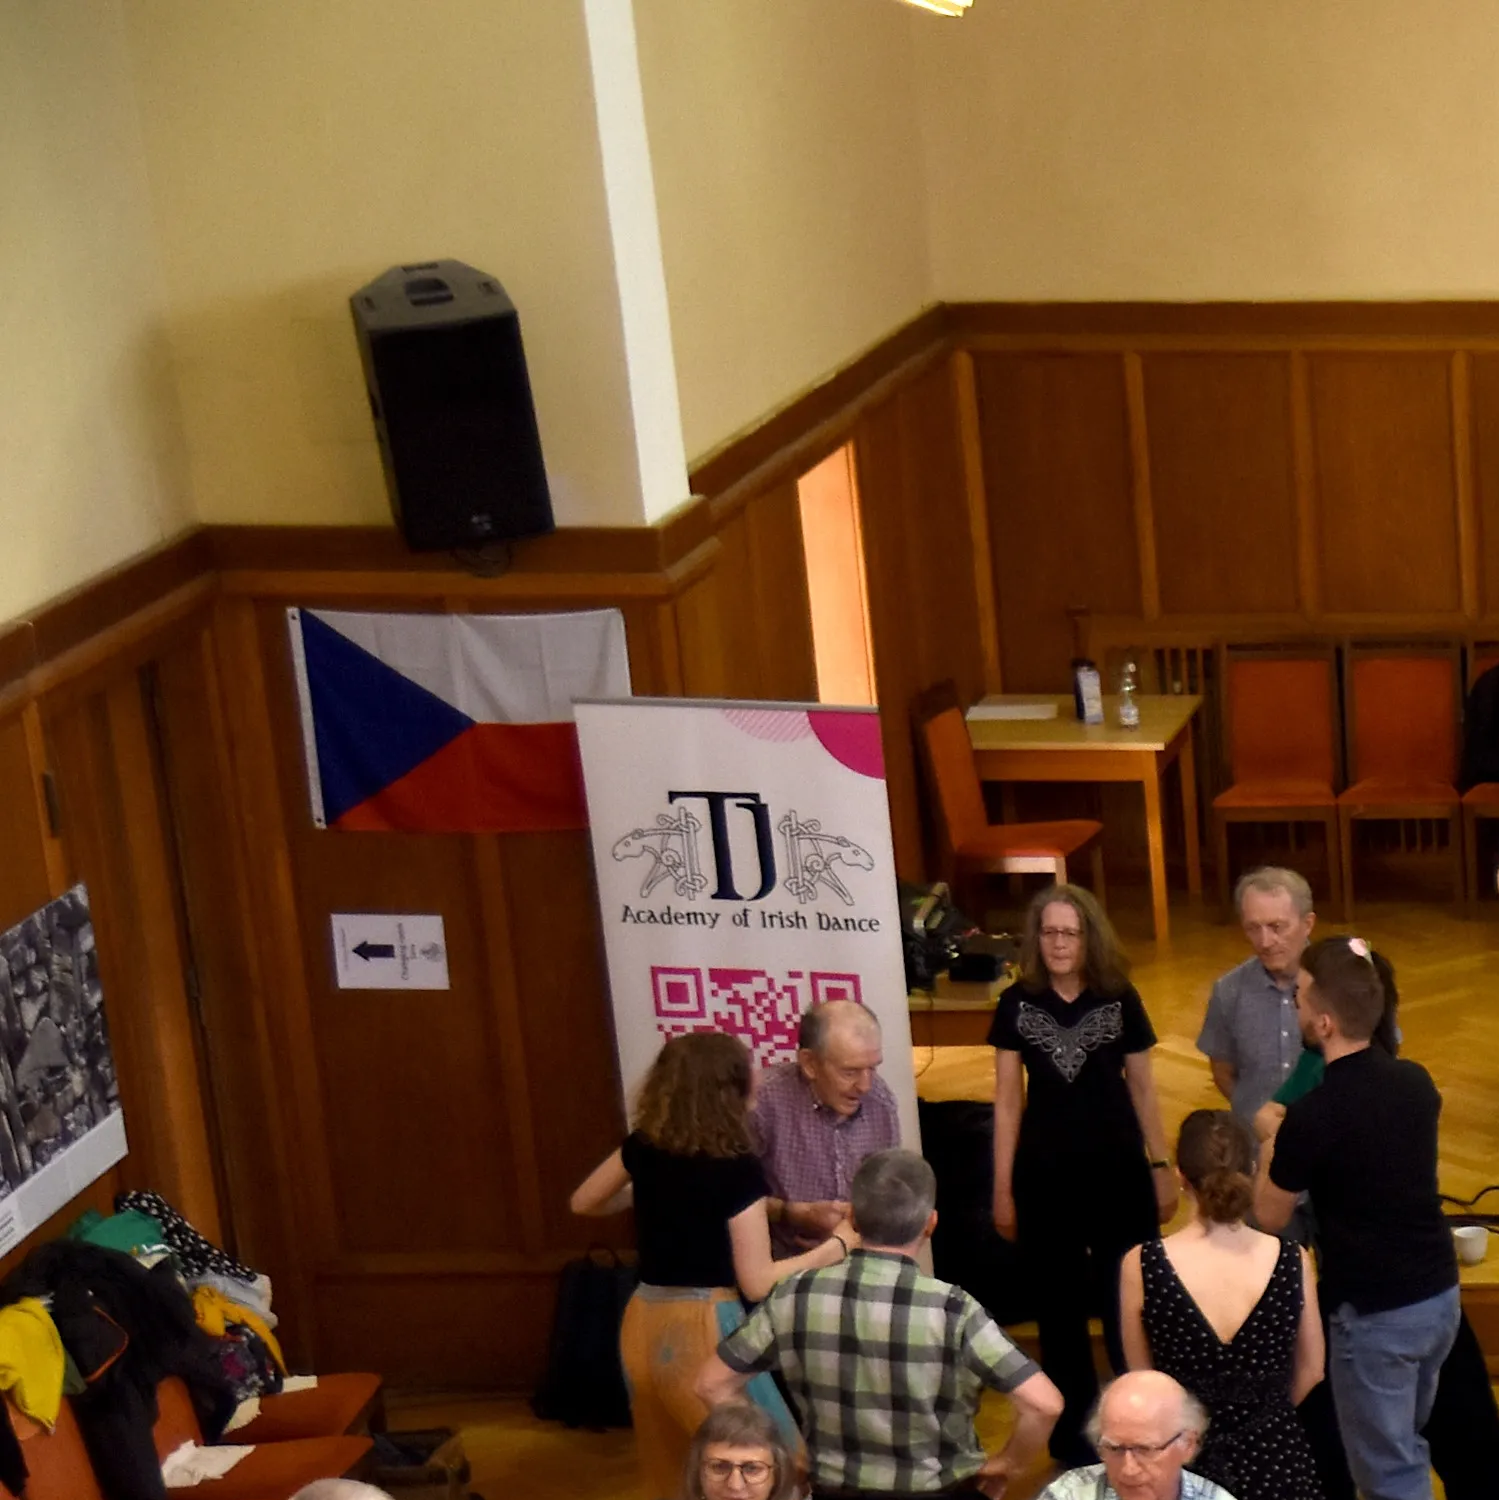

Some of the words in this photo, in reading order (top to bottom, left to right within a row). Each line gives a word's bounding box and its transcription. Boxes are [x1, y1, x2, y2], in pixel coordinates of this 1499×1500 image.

[621, 905, 720, 929] Academy
[732, 908, 751, 927] of
[761, 911, 807, 929] Irish
[816, 912, 879, 932] Dance
